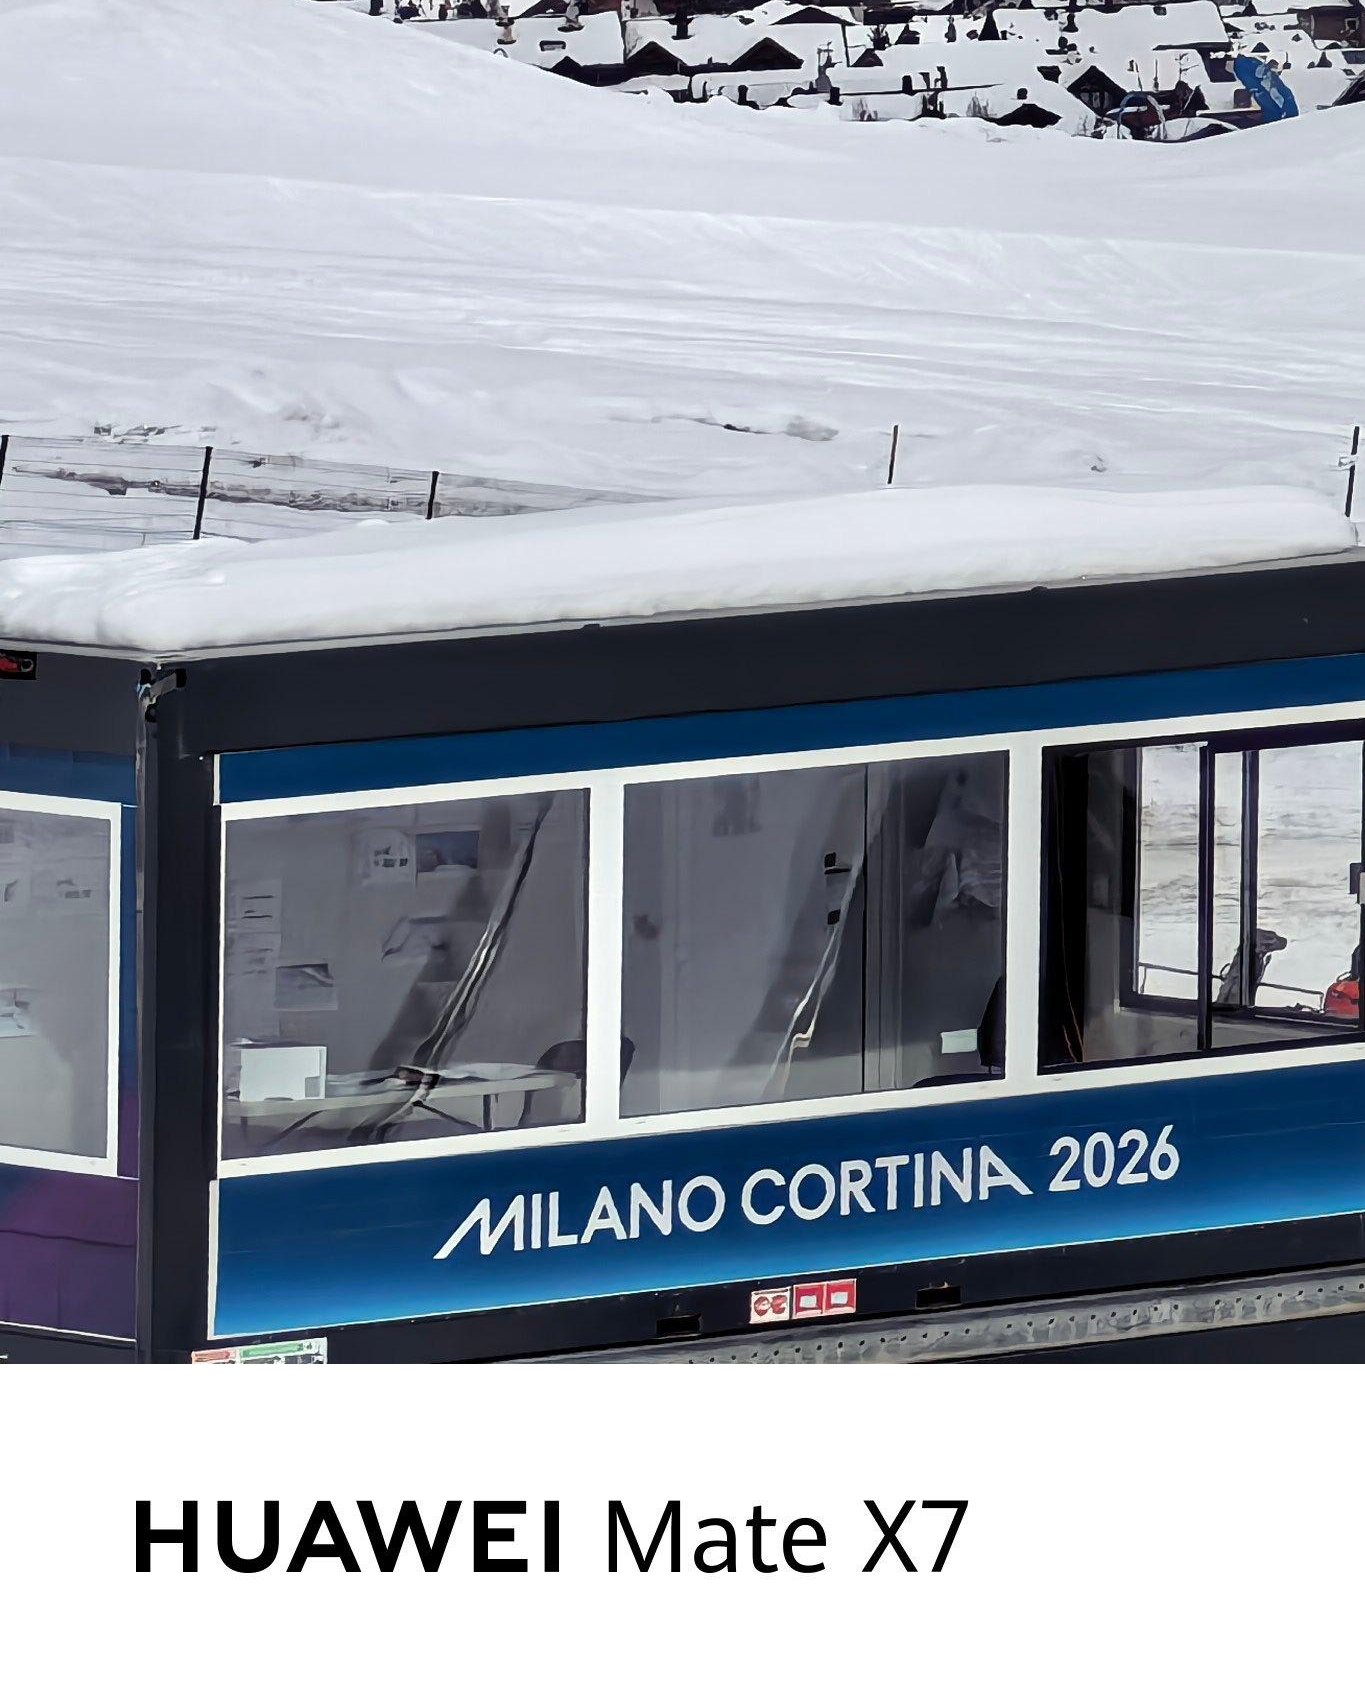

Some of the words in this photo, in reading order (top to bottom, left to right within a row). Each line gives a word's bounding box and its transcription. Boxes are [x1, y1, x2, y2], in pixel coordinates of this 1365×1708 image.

[433, 1175, 726, 1260] MILANO
[741, 1144, 1033, 1225] CORTINA
[1048, 1124, 1180, 1193] 2026
